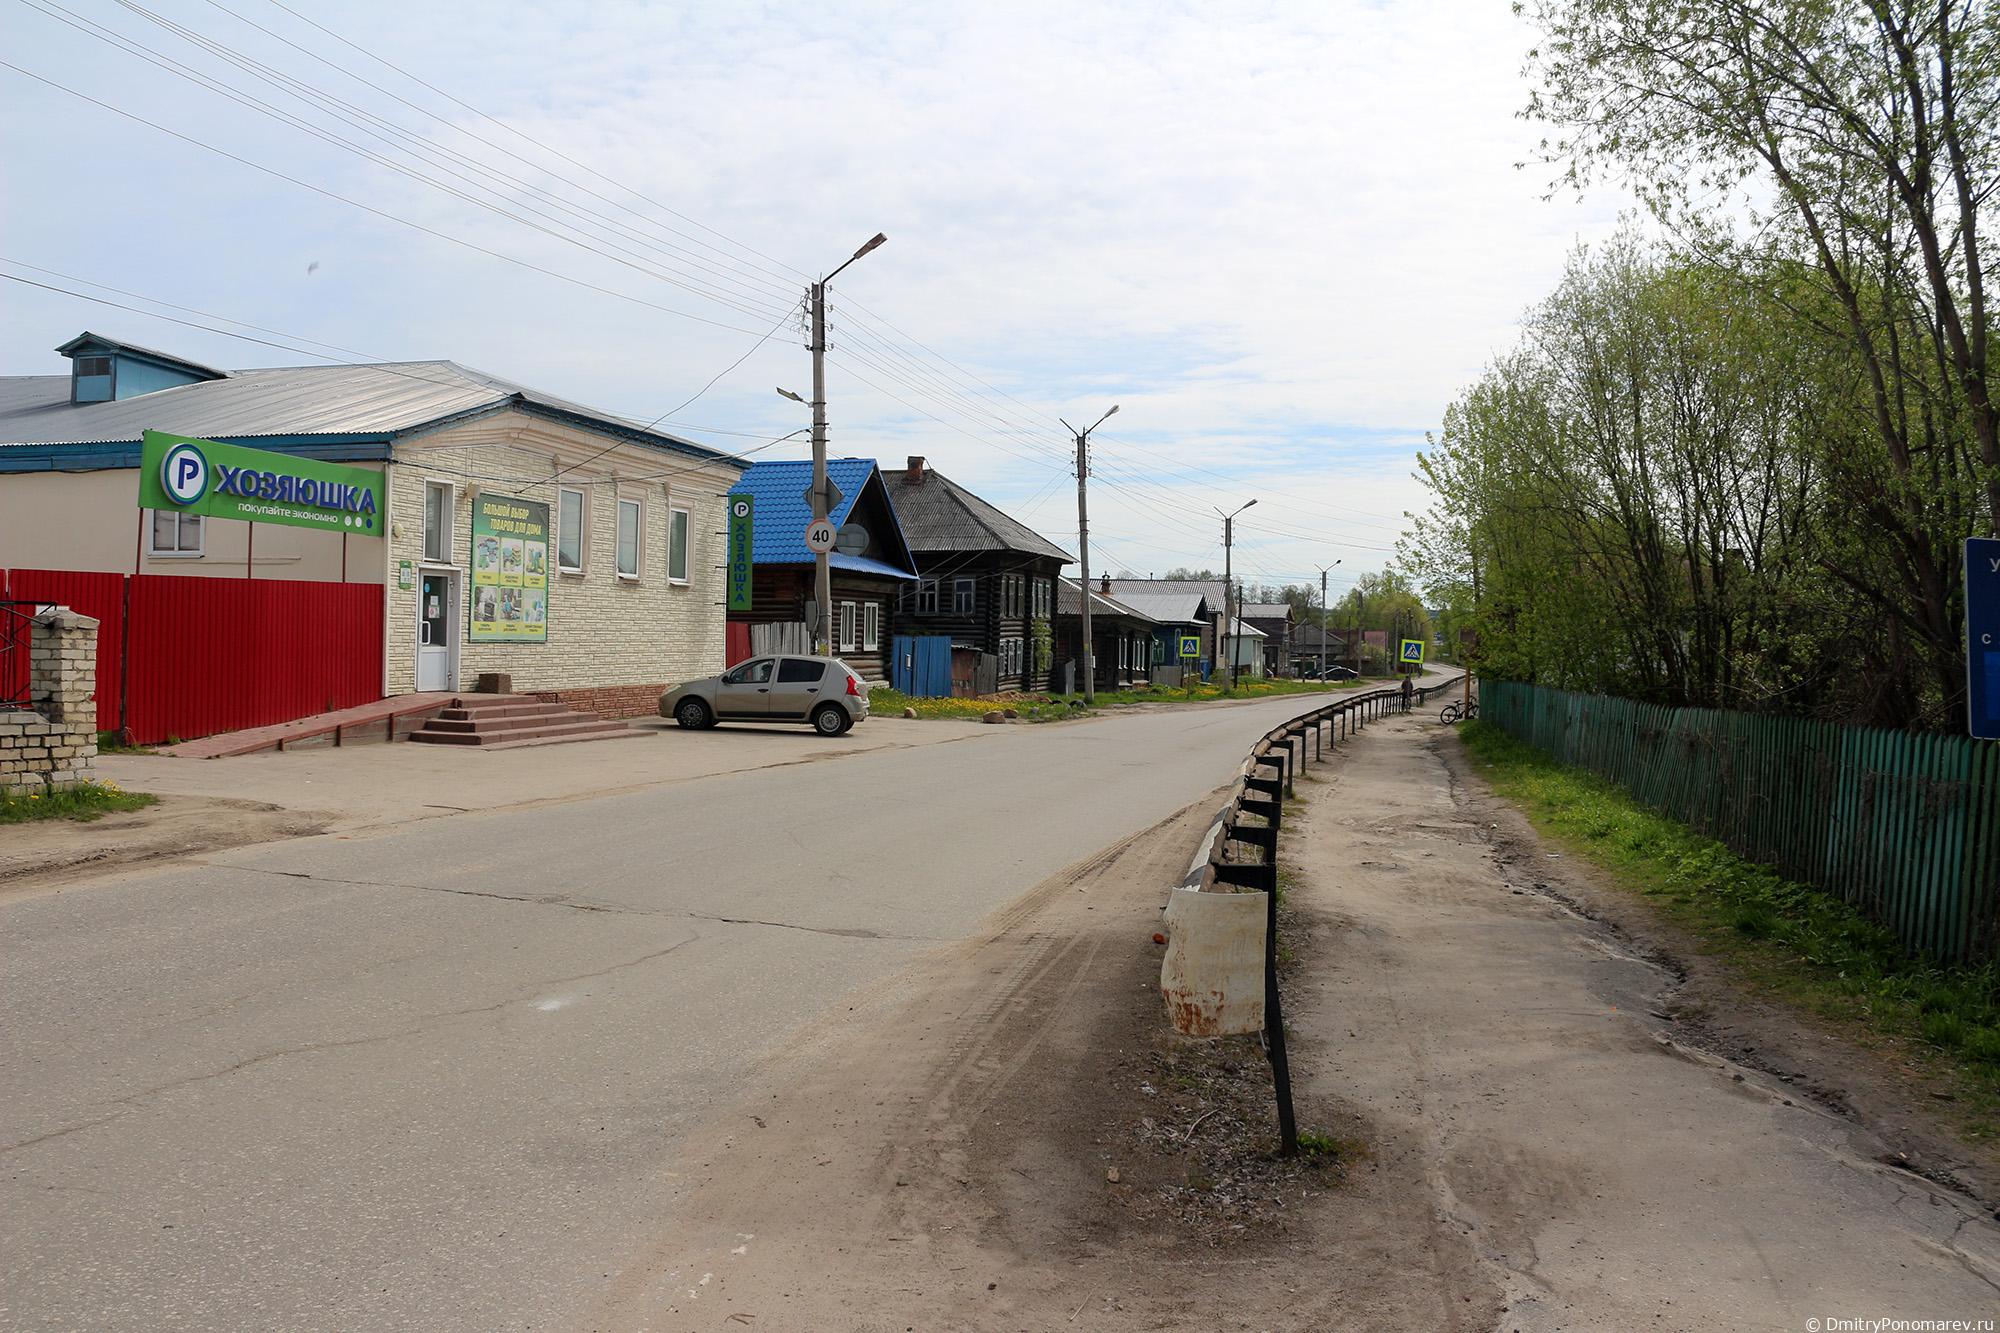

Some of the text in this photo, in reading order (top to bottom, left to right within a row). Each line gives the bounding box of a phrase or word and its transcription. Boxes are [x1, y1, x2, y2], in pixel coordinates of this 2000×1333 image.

[215, 464, 376, 514] ХОЗЯЮШКА
[238, 503, 338, 523] покупайте экономно
[483, 503, 529, 520] БОЛЬШОЙ ВЫБОР
[490, 518, 514, 532] ТОВАРОВ
[526, 523, 542, 536] ДОМА
[812, 529, 829, 543] 40
[734, 522, 747, 602] ХОЗЯЮШКА
